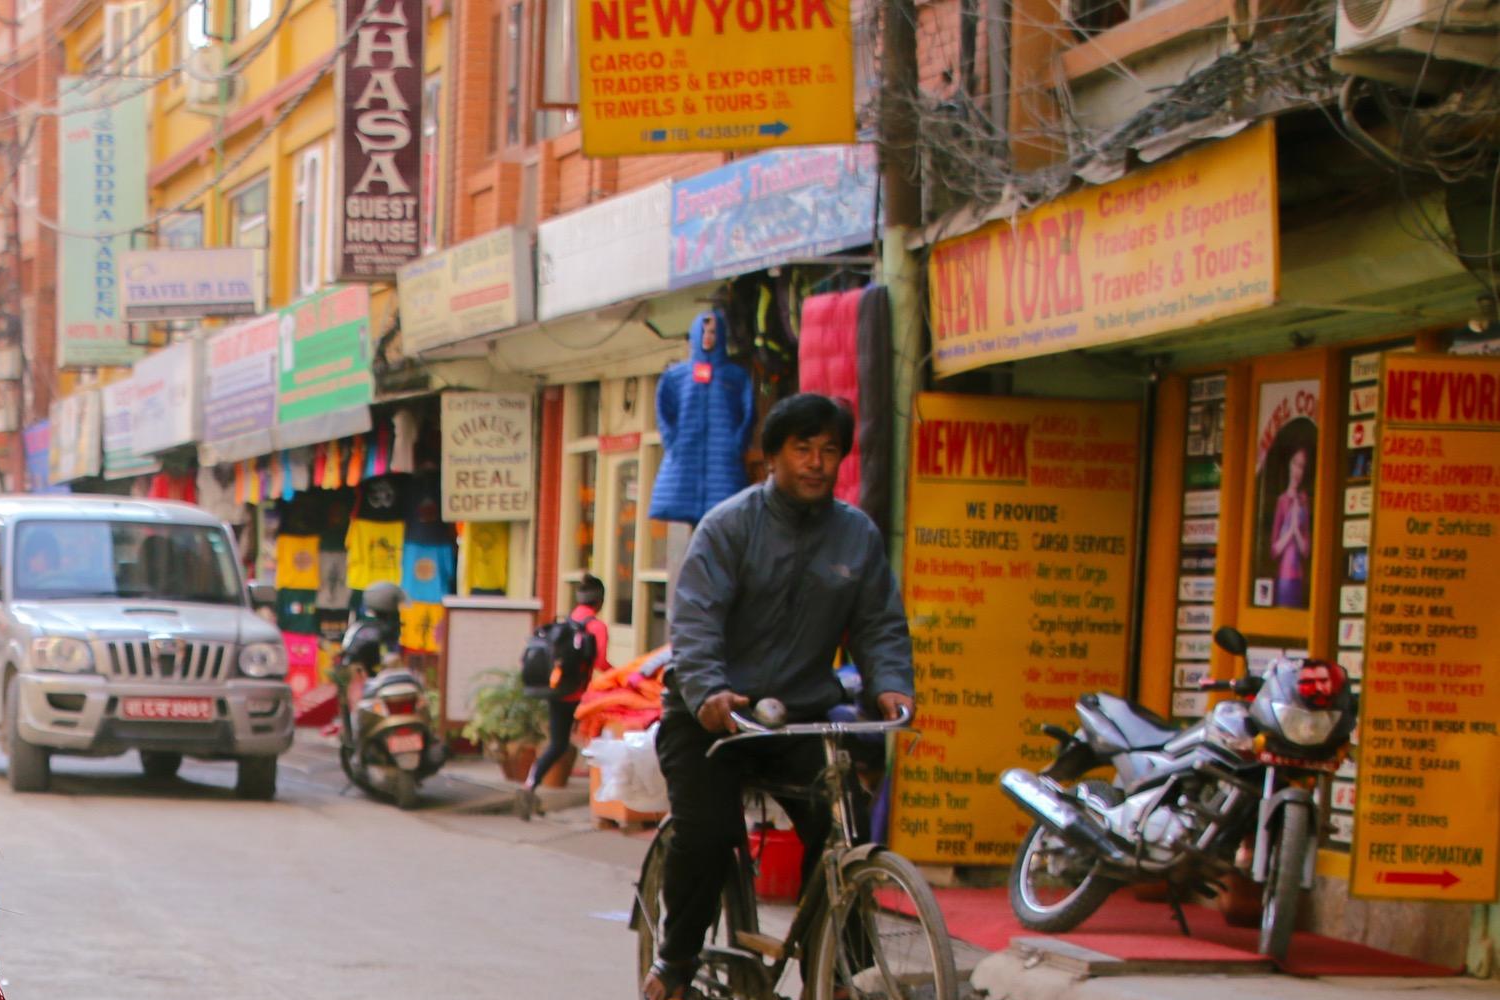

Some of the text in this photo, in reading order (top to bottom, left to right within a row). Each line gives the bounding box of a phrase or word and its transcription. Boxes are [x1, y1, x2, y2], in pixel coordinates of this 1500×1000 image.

[590, 52, 664, 72] CARGO
[591, 67, 812, 96] TRADERS & EXPORTER
[593, 94, 767, 120] TRAVELS & TOURS
[94, 133, 116, 222] BUDDHA
[346, 195, 417, 220] GUEST
[676, 174, 743, 225] Everest
[1098, 180, 1161, 219] Cargo
[346, 220, 418, 242] HOUSE
[1092, 190, 1258, 261] Traders & Exporter
[935, 207, 1085, 341] NEW YORK
[1092, 240, 1251, 307] Travels & Tours
[129, 283, 186, 300] TRAVEL
[917, 419, 1030, 479] NEWYORK
[456, 470, 521, 490] REAL
[449, 490, 529, 512] COFFEE!
[966, 502, 987, 520] WE
[1407, 517, 1432, 537] Our
[914, 528, 1019, 551] TRAVELS SERVICES
[1032, 532, 1126, 556] CARGO SERVICES
[936, 839, 967, 855] FREE
[1369, 843, 1484, 867] FREE INFORMATION
